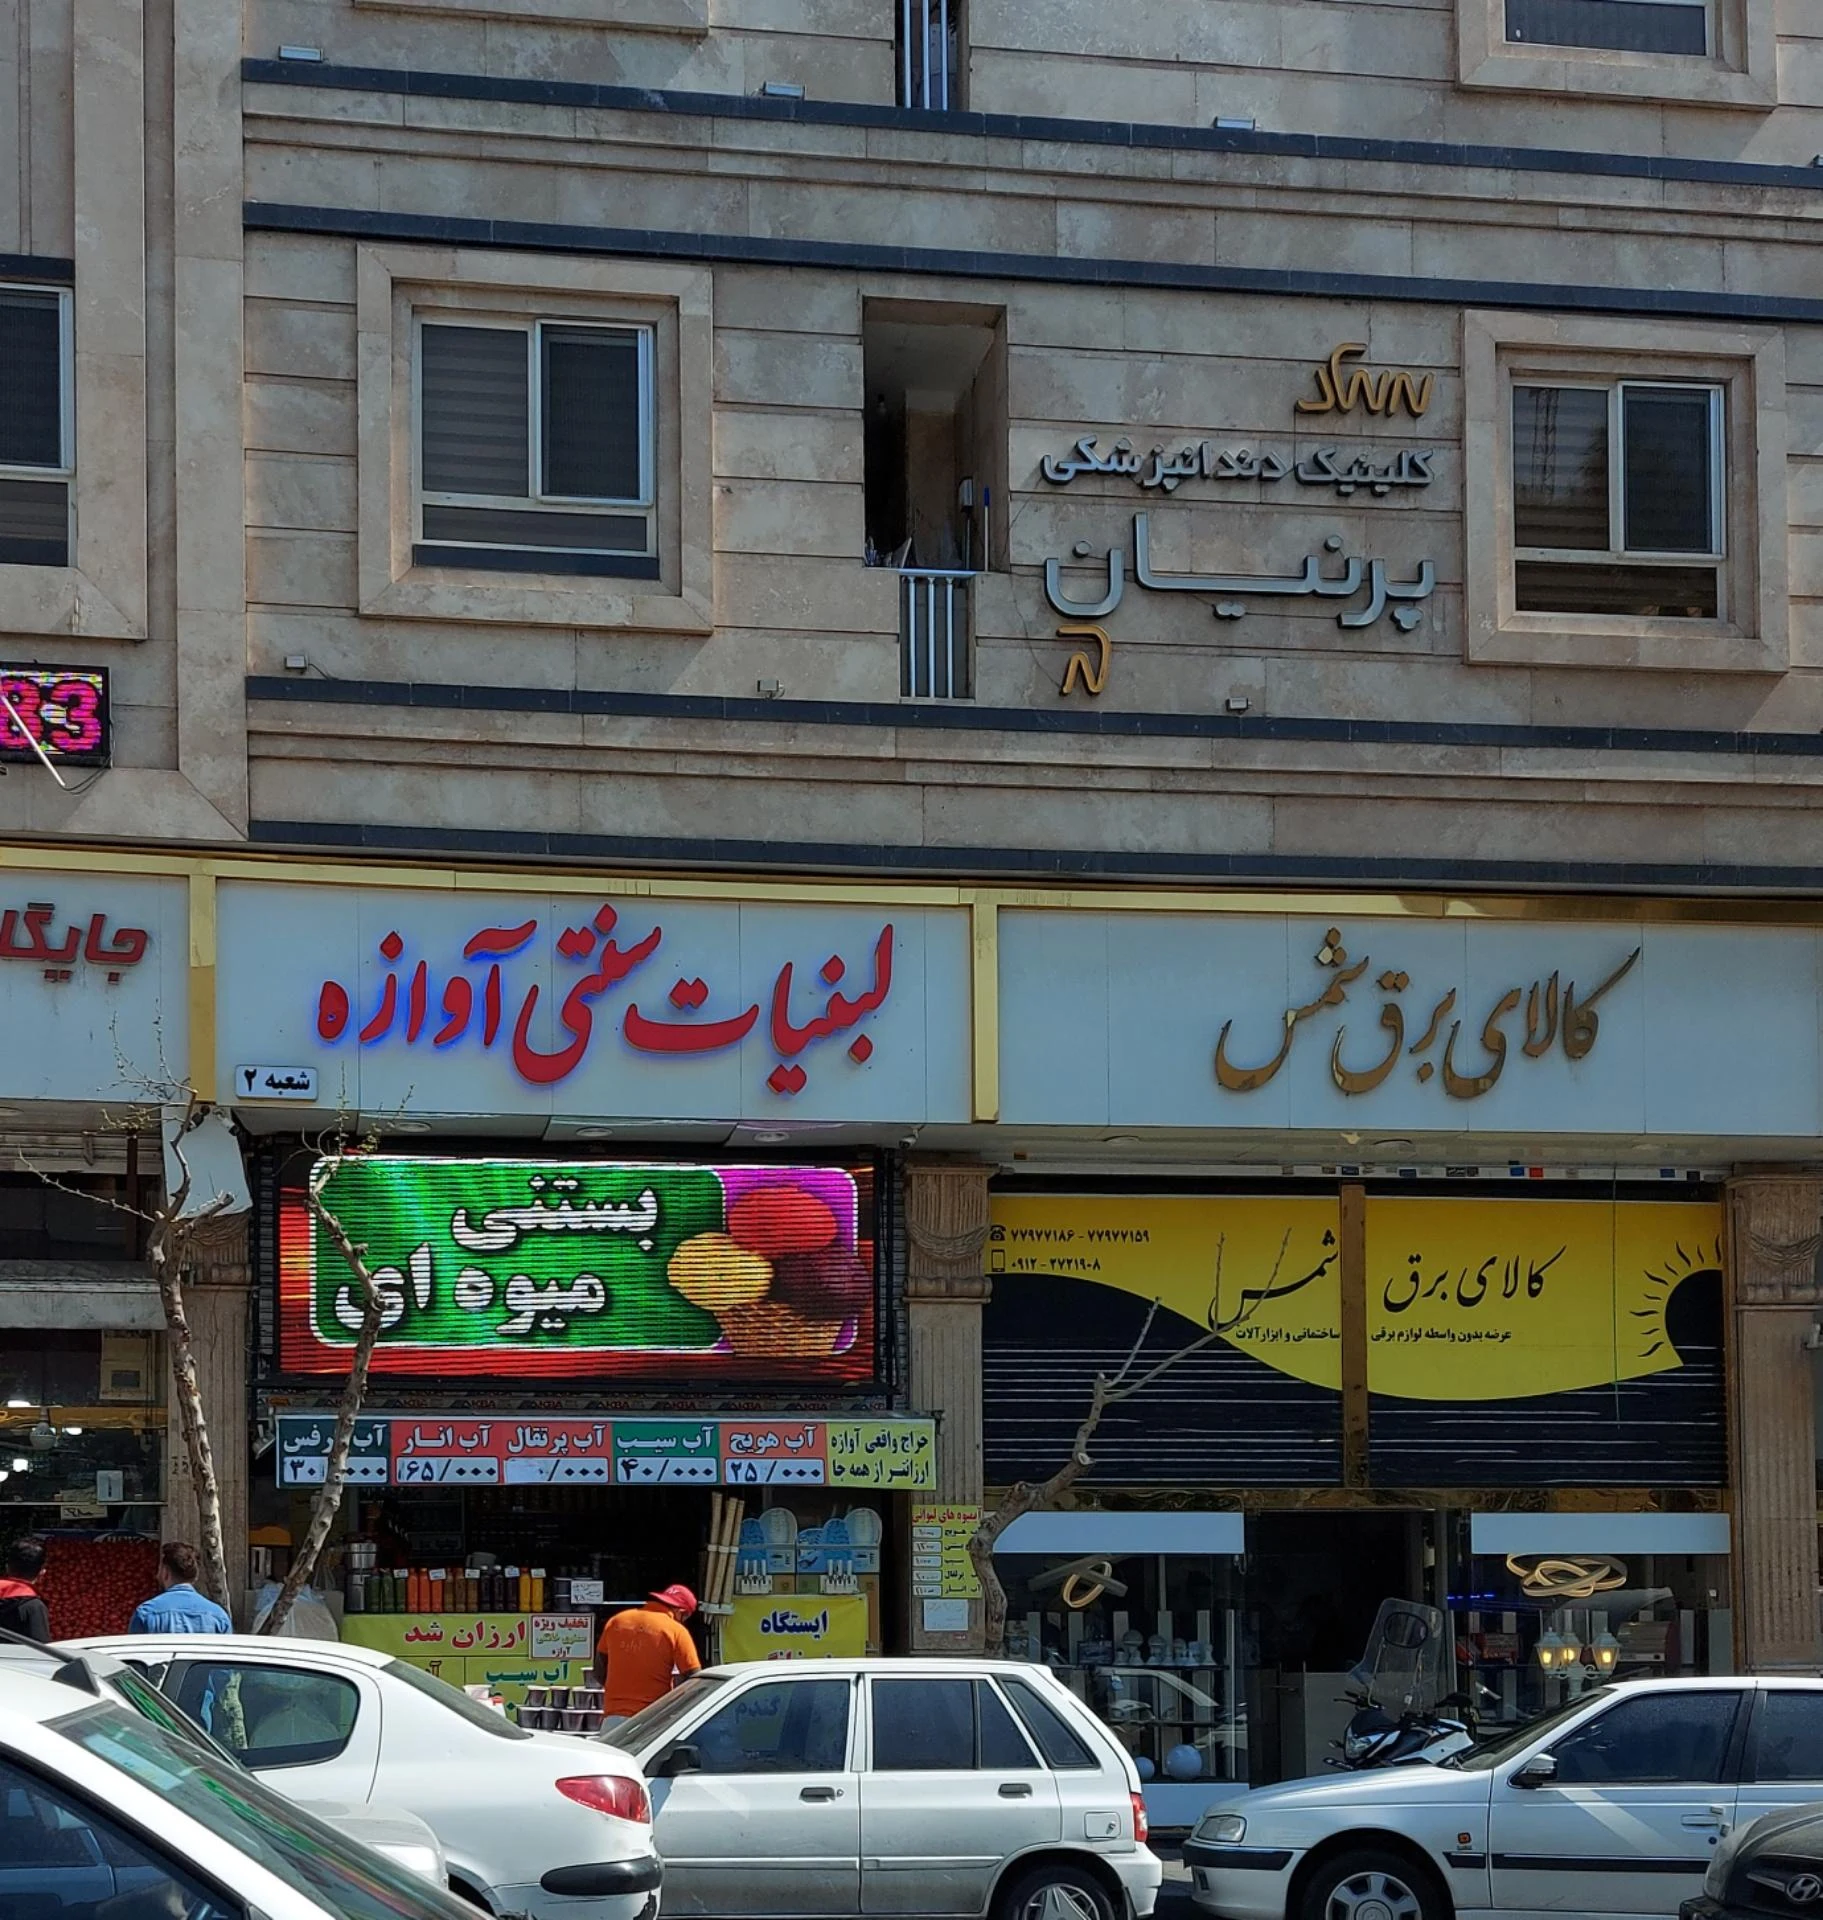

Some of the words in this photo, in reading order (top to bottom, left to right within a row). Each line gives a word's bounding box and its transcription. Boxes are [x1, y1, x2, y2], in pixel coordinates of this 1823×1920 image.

[1041, 434, 1294, 492] دندانپزشکی
[1294, 446, 1434, 496] کلینیک
[1043, 511, 1436, 632] پرنیان
[316, 918, 538, 1046] آوازه
[512, 903, 662, 1085] سنتی
[622, 922, 894, 1095] لبنیات
[1214, 926, 1370, 1093] شمس
[1331, 969, 1456, 1097] برق
[1443, 946, 1641, 1100] کالای
[242, 1068, 257, 1092] ۲
[264, 1070, 312, 1093] شعبه
[451, 1174, 660, 1253] بستنی
[1209, 1227, 1341, 1329] شمس
[1383, 1253, 1449, 1313] برق
[1455, 1244, 1567, 1307] کالای
[1284, 1333, 1290, 1343] و
[1292, 1327, 1341, 1342] ساختمانی
[1371, 1328, 1396, 1343] برقی
[1397, 1327, 1422, 1342] لوازم
[1424, 1328, 1456, 1342] واسطه
[1458, 1330, 1483, 1343] بدون
[1484, 1329, 1511, 1343] عرضه
[283, 1422, 335, 1454] رفس
[352, 1423, 387, 1450] آب
[402, 1425, 453, 1455] انار
[460, 1423, 492, 1449] آب
[506, 1425, 569, 1456] پرتقال
[572, 1424, 606, 1450] آب
[616, 1433, 677, 1453] سیب
[682, 1425, 714, 1451] آب
[729, 1430, 780, 1455] هویج
[784, 1425, 817, 1452] آب
[831, 1426, 861, 1455] آوازه
[864, 1427, 898, 1455] واقعی
[900, 1428, 929, 1457] حراج
[405, 1458, 497, 1482] ۶۵/۰۰۰
[619, 1458, 714, 1483] ۴۰/۰۰۰
[730, 1459, 821, 1483] ۲۵/۰۰۰
[831, 1460, 846, 1484] جا
[848, 1465, 871, 1483] همه
[873, 1460, 884, 1483] از
[887, 1459, 929, 1485] ارزانتر
[404, 1621, 445, 1643] شد
[450, 1619, 526, 1649] ارزان
[760, 1607, 829, 1641] ایستگاه
[485, 1669, 538, 1687] سیب
[542, 1659, 569, 1685] آب
